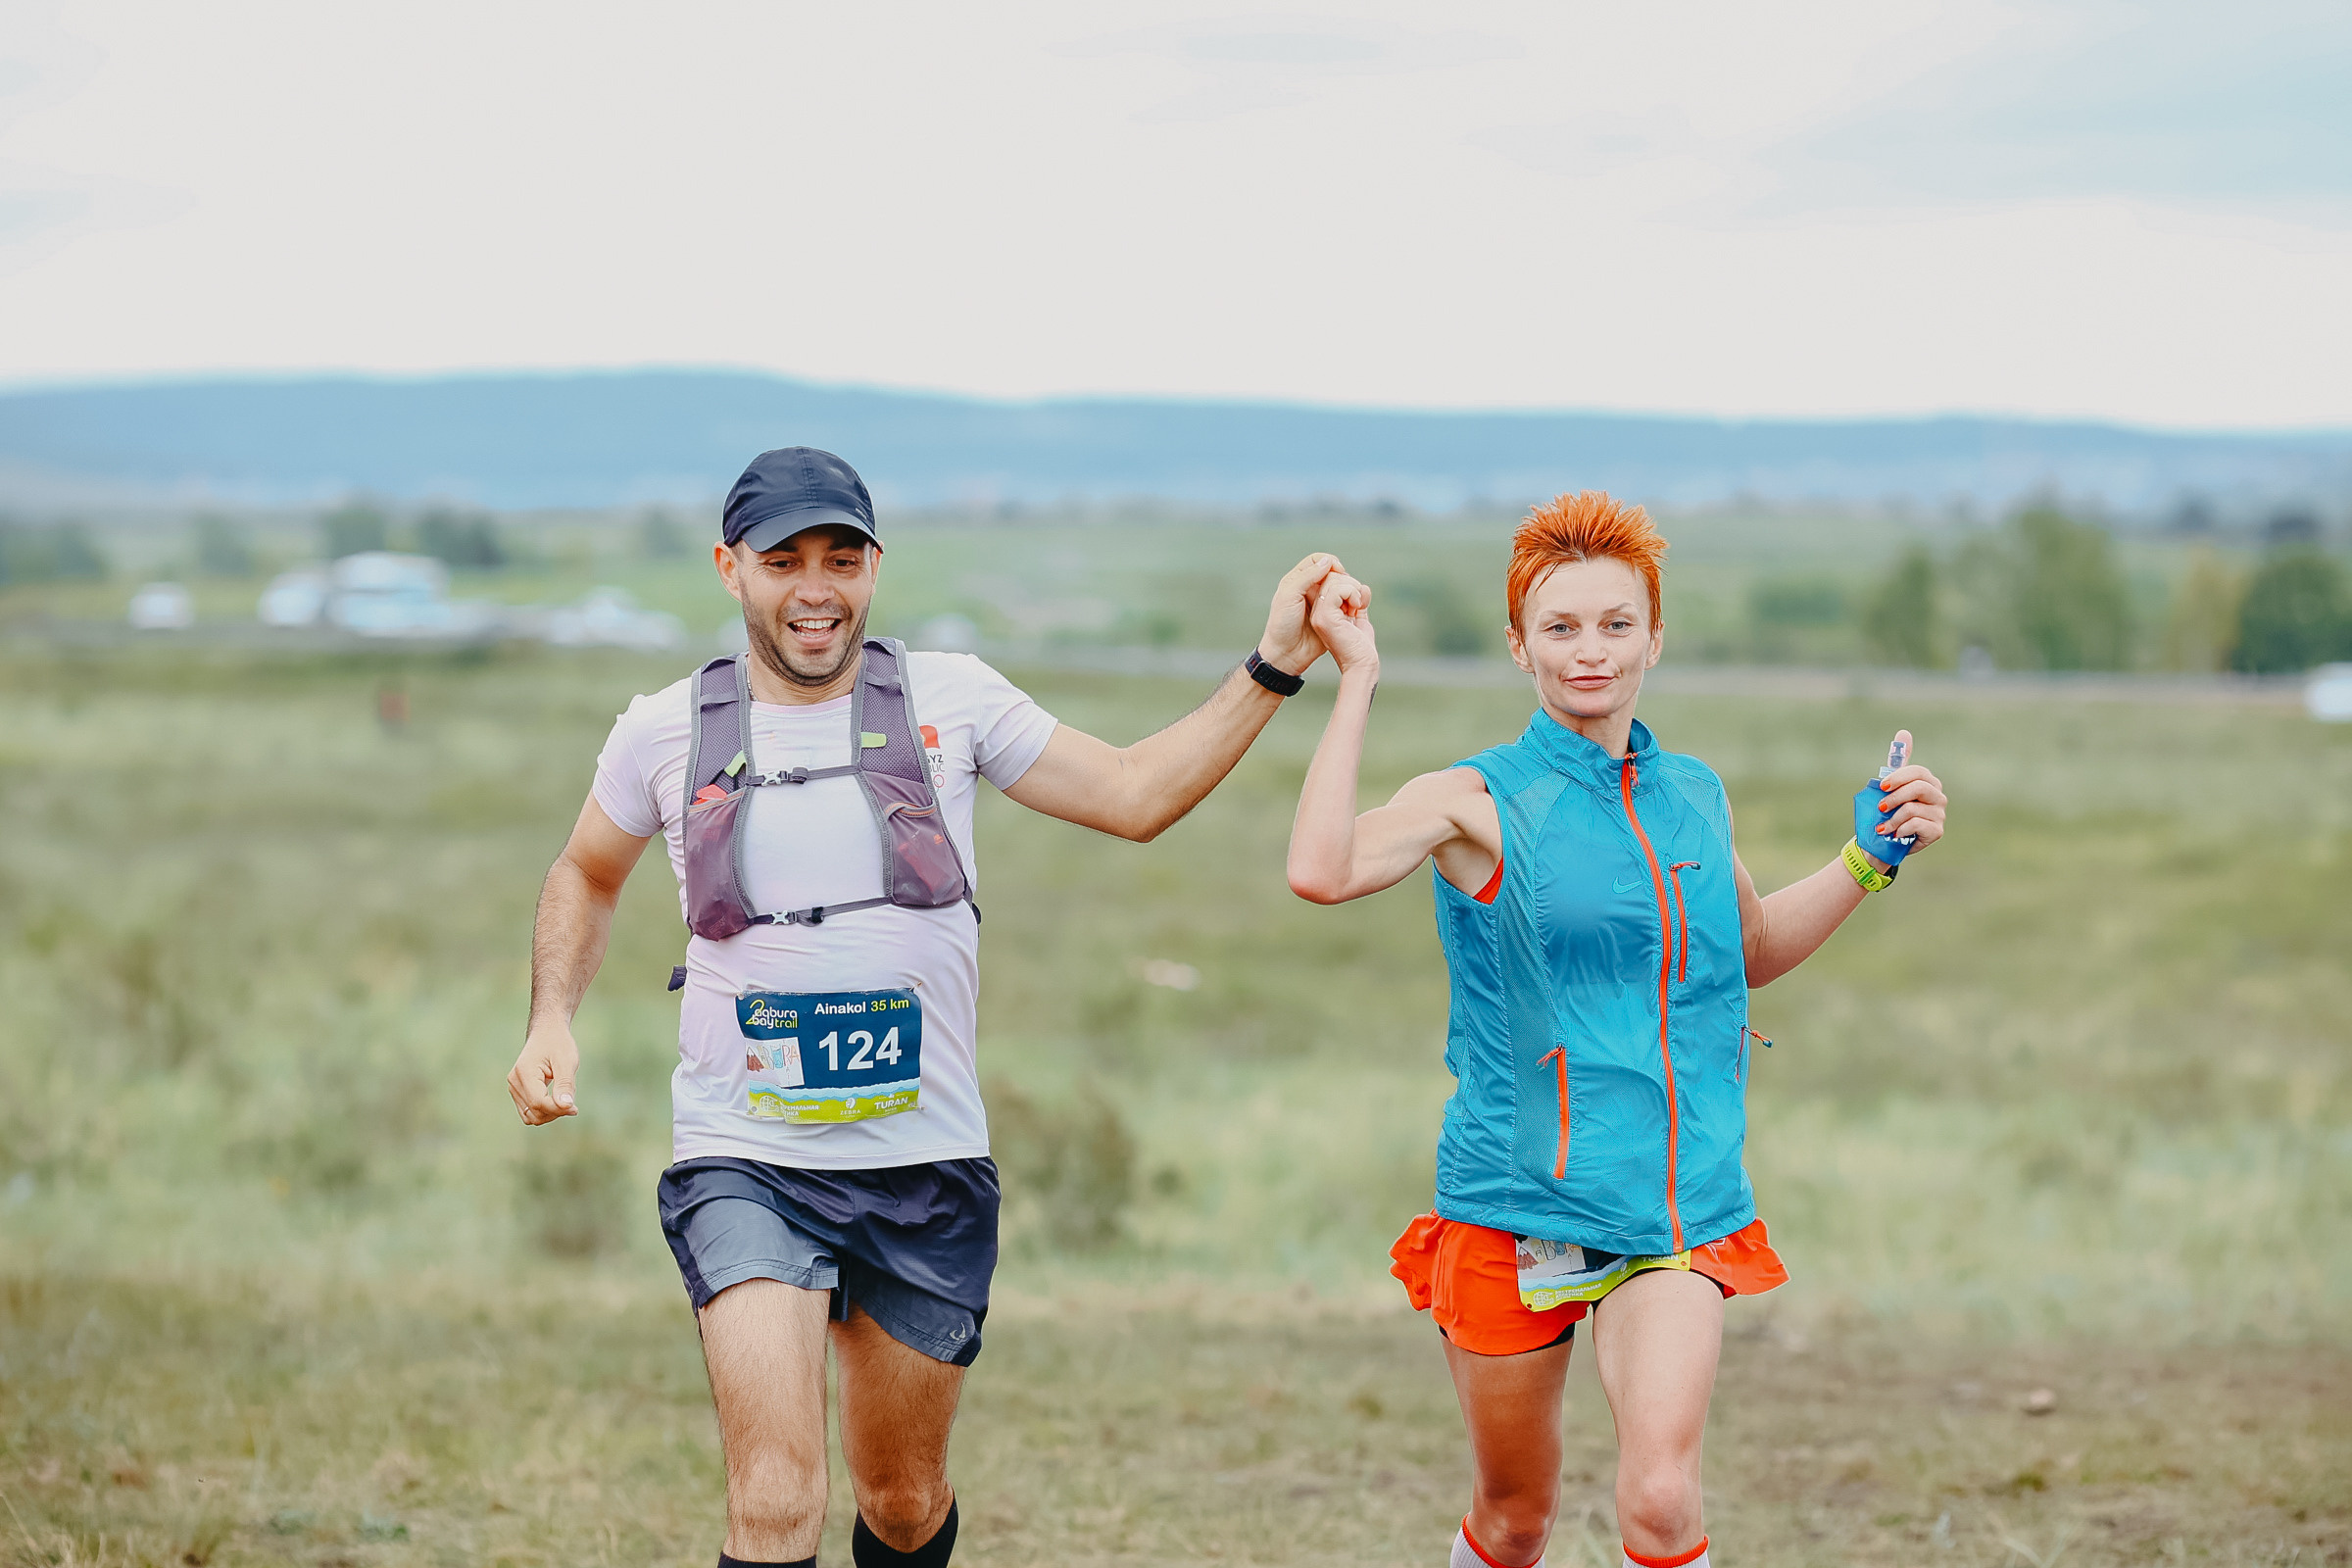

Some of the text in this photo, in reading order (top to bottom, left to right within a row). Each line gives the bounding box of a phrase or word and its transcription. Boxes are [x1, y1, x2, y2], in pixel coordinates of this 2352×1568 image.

[814, 998, 909, 1015] Ainakol 35 km
[818, 1026, 903, 1071] 124
[874, 1096, 909, 1110] TURAN
